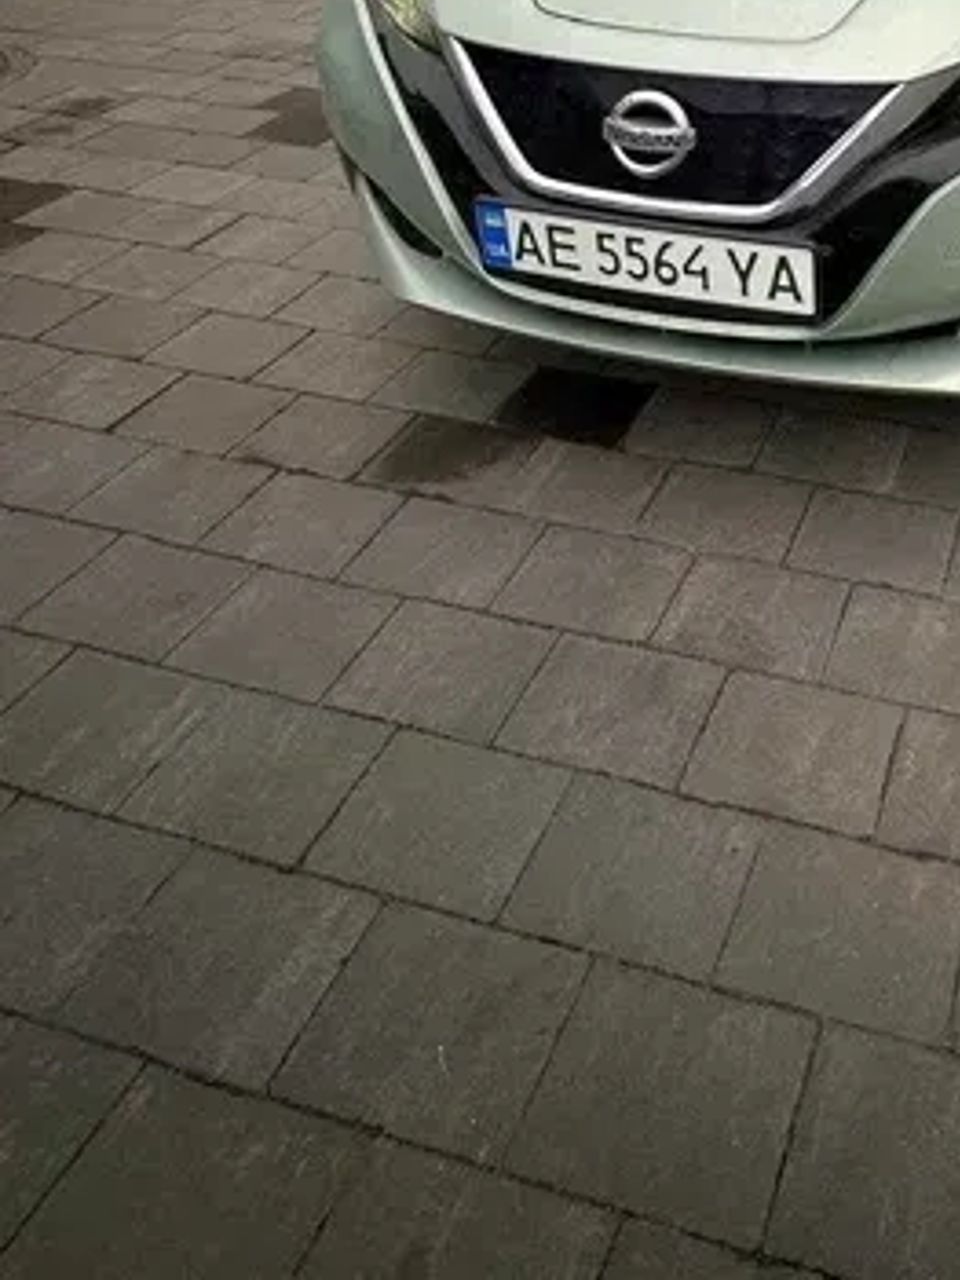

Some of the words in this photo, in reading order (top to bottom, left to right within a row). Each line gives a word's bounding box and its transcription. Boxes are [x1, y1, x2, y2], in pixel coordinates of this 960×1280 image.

[515, 220, 581, 271] AE
[596, 232, 709, 290] 5564
[727, 248, 802, 303] YA
